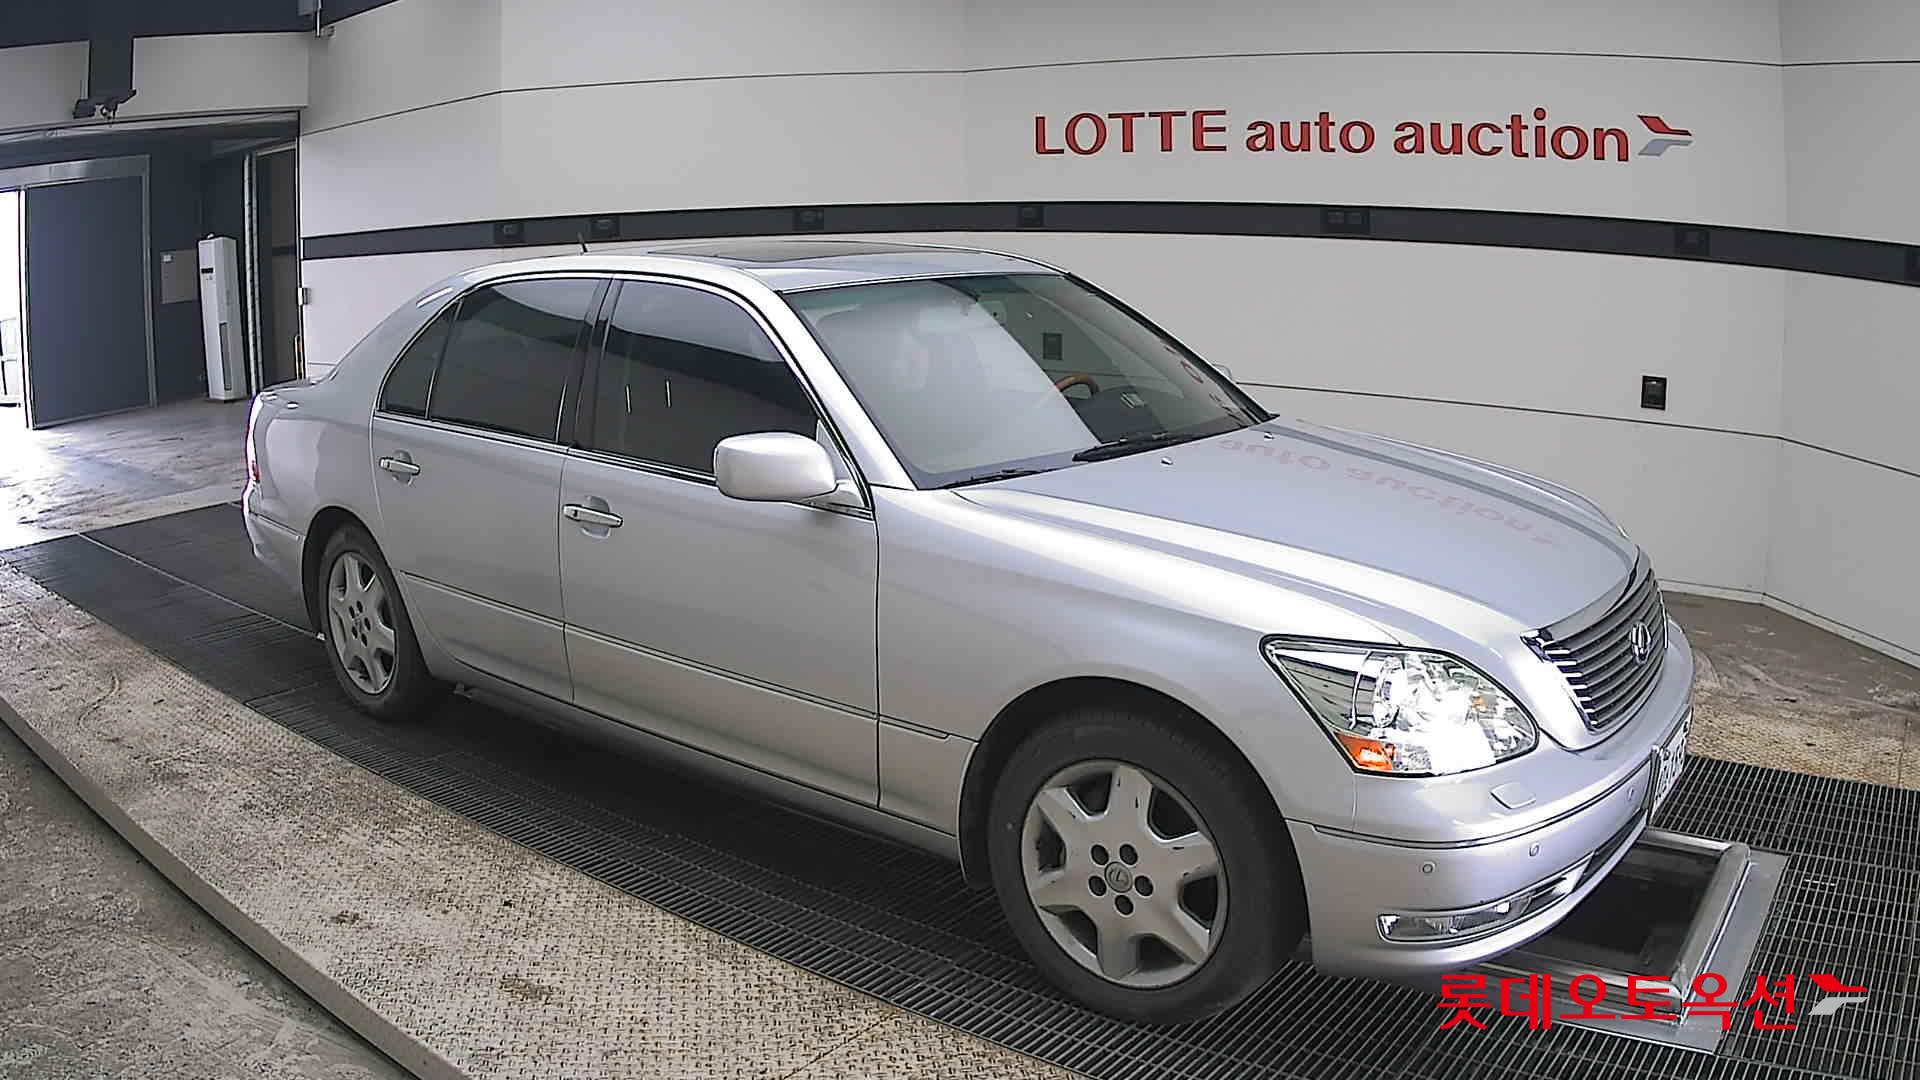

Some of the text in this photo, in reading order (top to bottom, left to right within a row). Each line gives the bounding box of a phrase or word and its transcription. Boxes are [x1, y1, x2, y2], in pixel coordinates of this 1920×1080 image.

[1034, 107, 1630, 162] LOTTE auto auction
